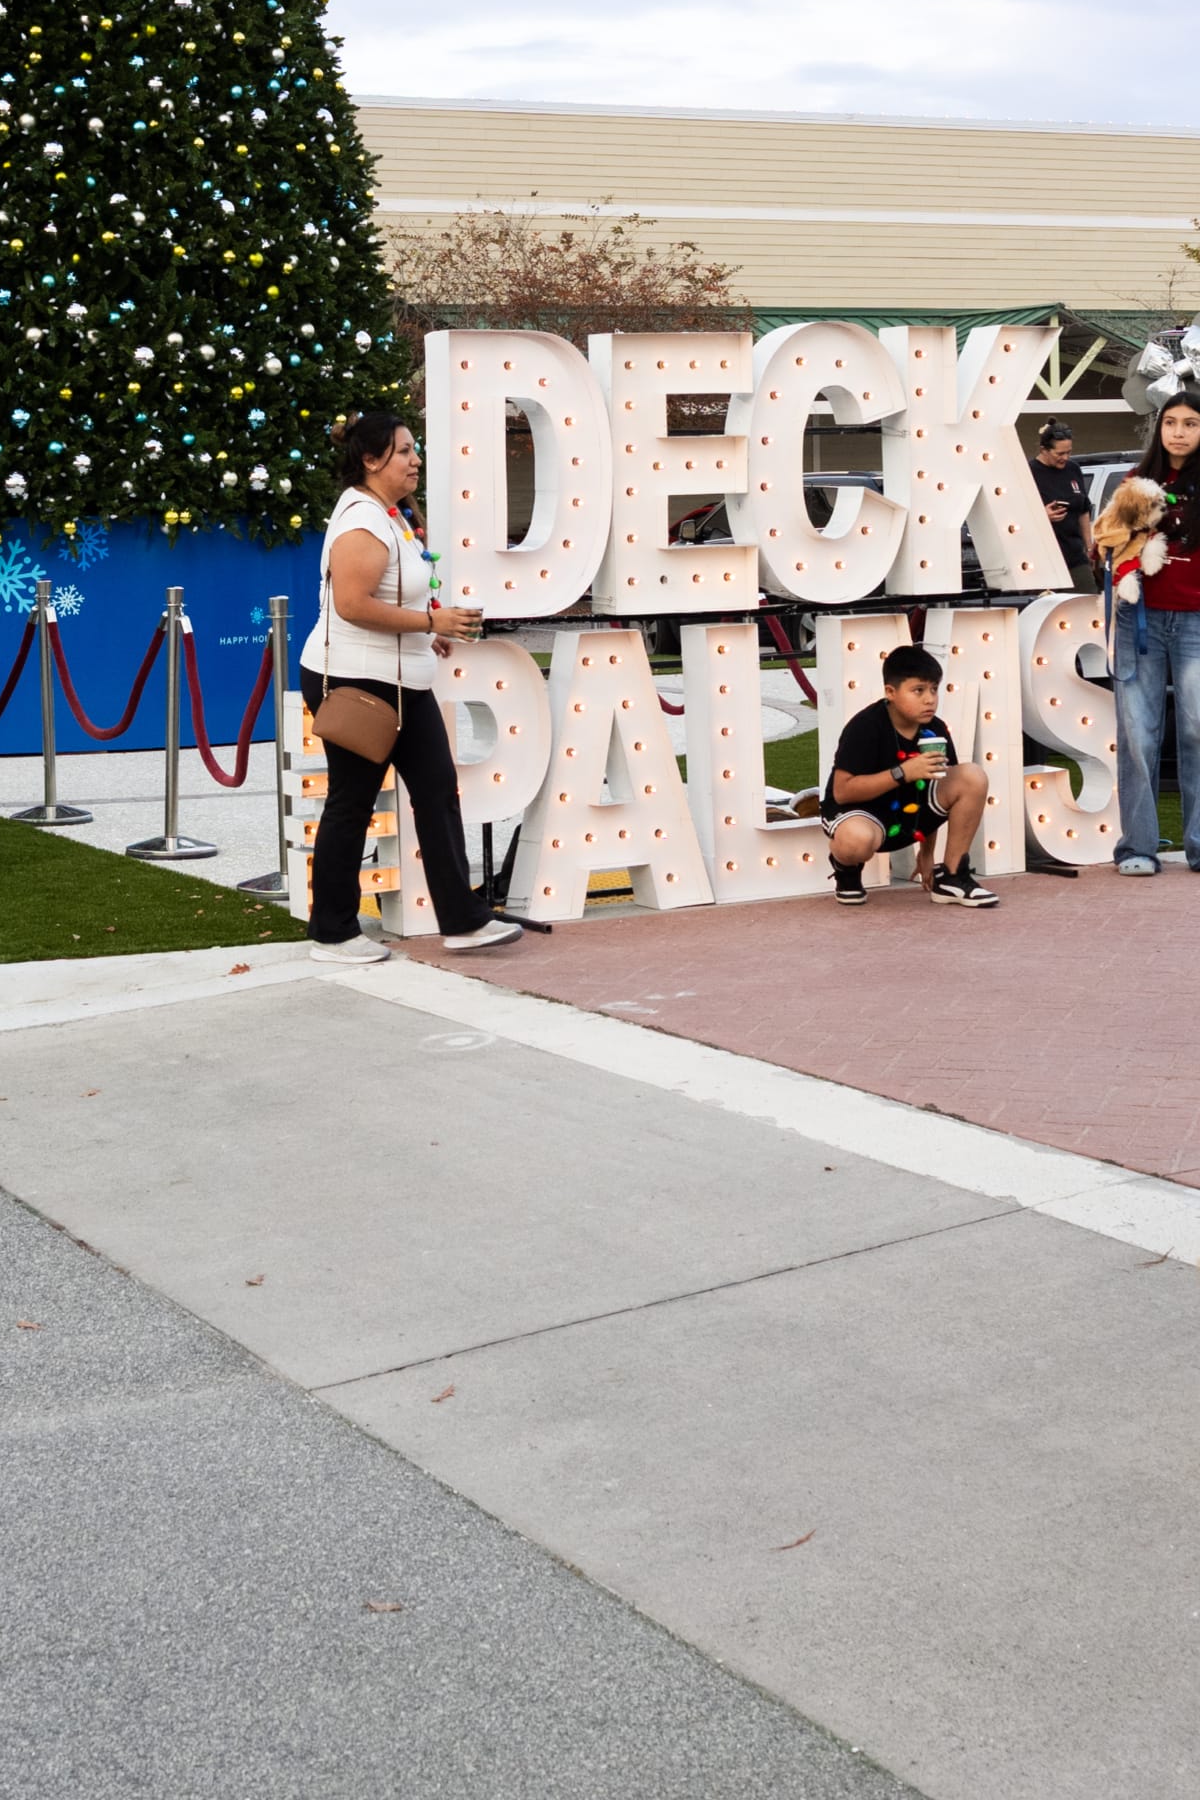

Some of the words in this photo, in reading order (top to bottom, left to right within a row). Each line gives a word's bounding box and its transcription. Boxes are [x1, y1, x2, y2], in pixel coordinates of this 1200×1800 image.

[425, 321, 1072, 619] DECK
[219, 635, 249, 646] HAPPY
[381, 593, 1119, 936] PALMS
